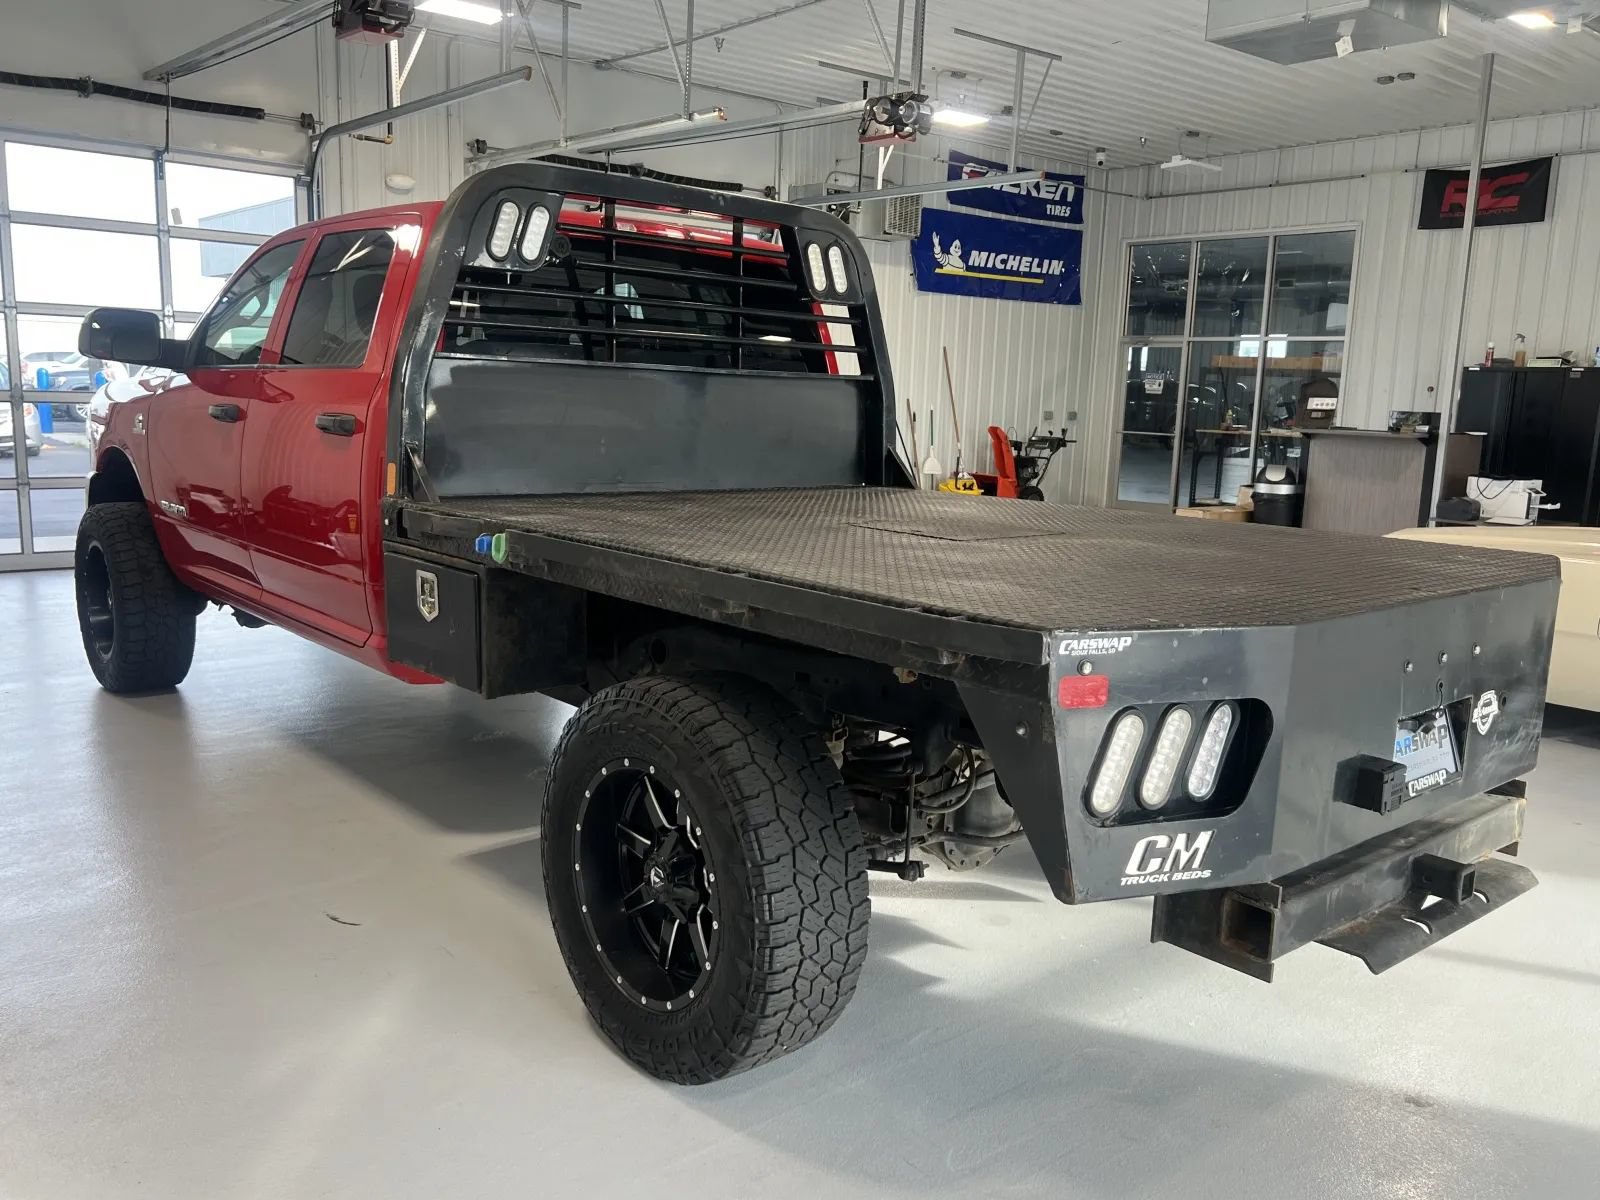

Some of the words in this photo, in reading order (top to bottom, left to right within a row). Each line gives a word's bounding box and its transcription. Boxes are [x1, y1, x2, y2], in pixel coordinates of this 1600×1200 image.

[1046, 204, 1071, 217] TIRES
[968, 250, 1064, 275] MICHELIN
[1059, 637, 1132, 655] CARSWAP
[1408, 769, 1447, 797] CARSWAP
[1125, 830, 1214, 875] CM
[1120, 873, 1170, 886] TRUCK
[1171, 869, 1212, 881] BEDS
